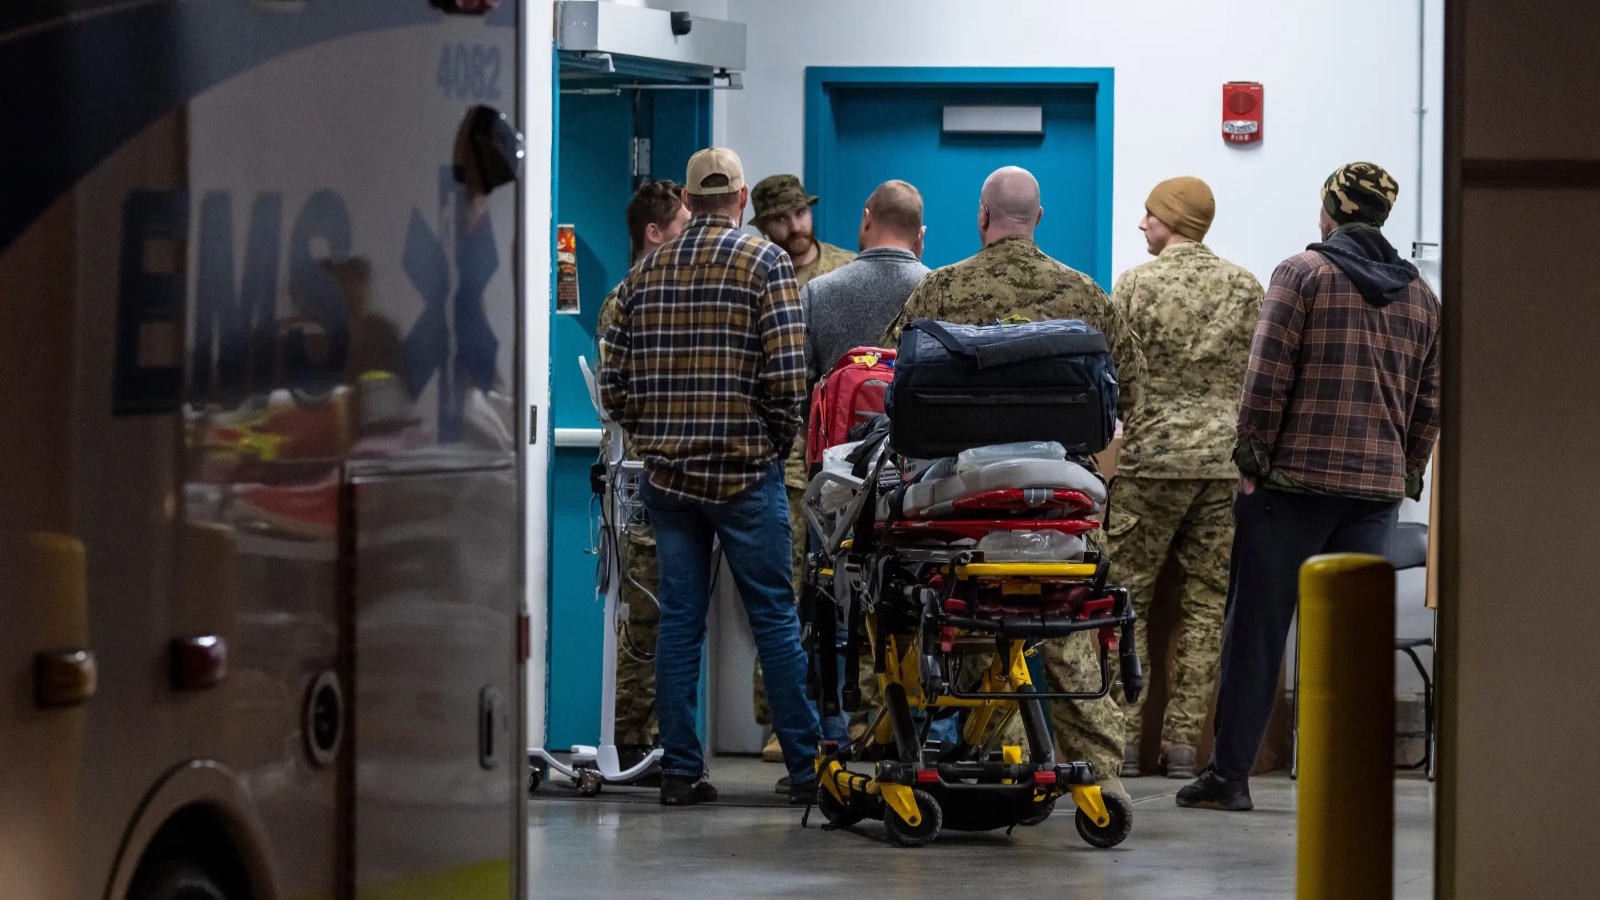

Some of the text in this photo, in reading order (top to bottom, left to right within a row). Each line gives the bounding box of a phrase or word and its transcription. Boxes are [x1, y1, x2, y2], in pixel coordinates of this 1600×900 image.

[437, 42, 502, 100] 4082
[1230, 133, 1249, 142] FIRE
[112, 187, 352, 416] EMS
